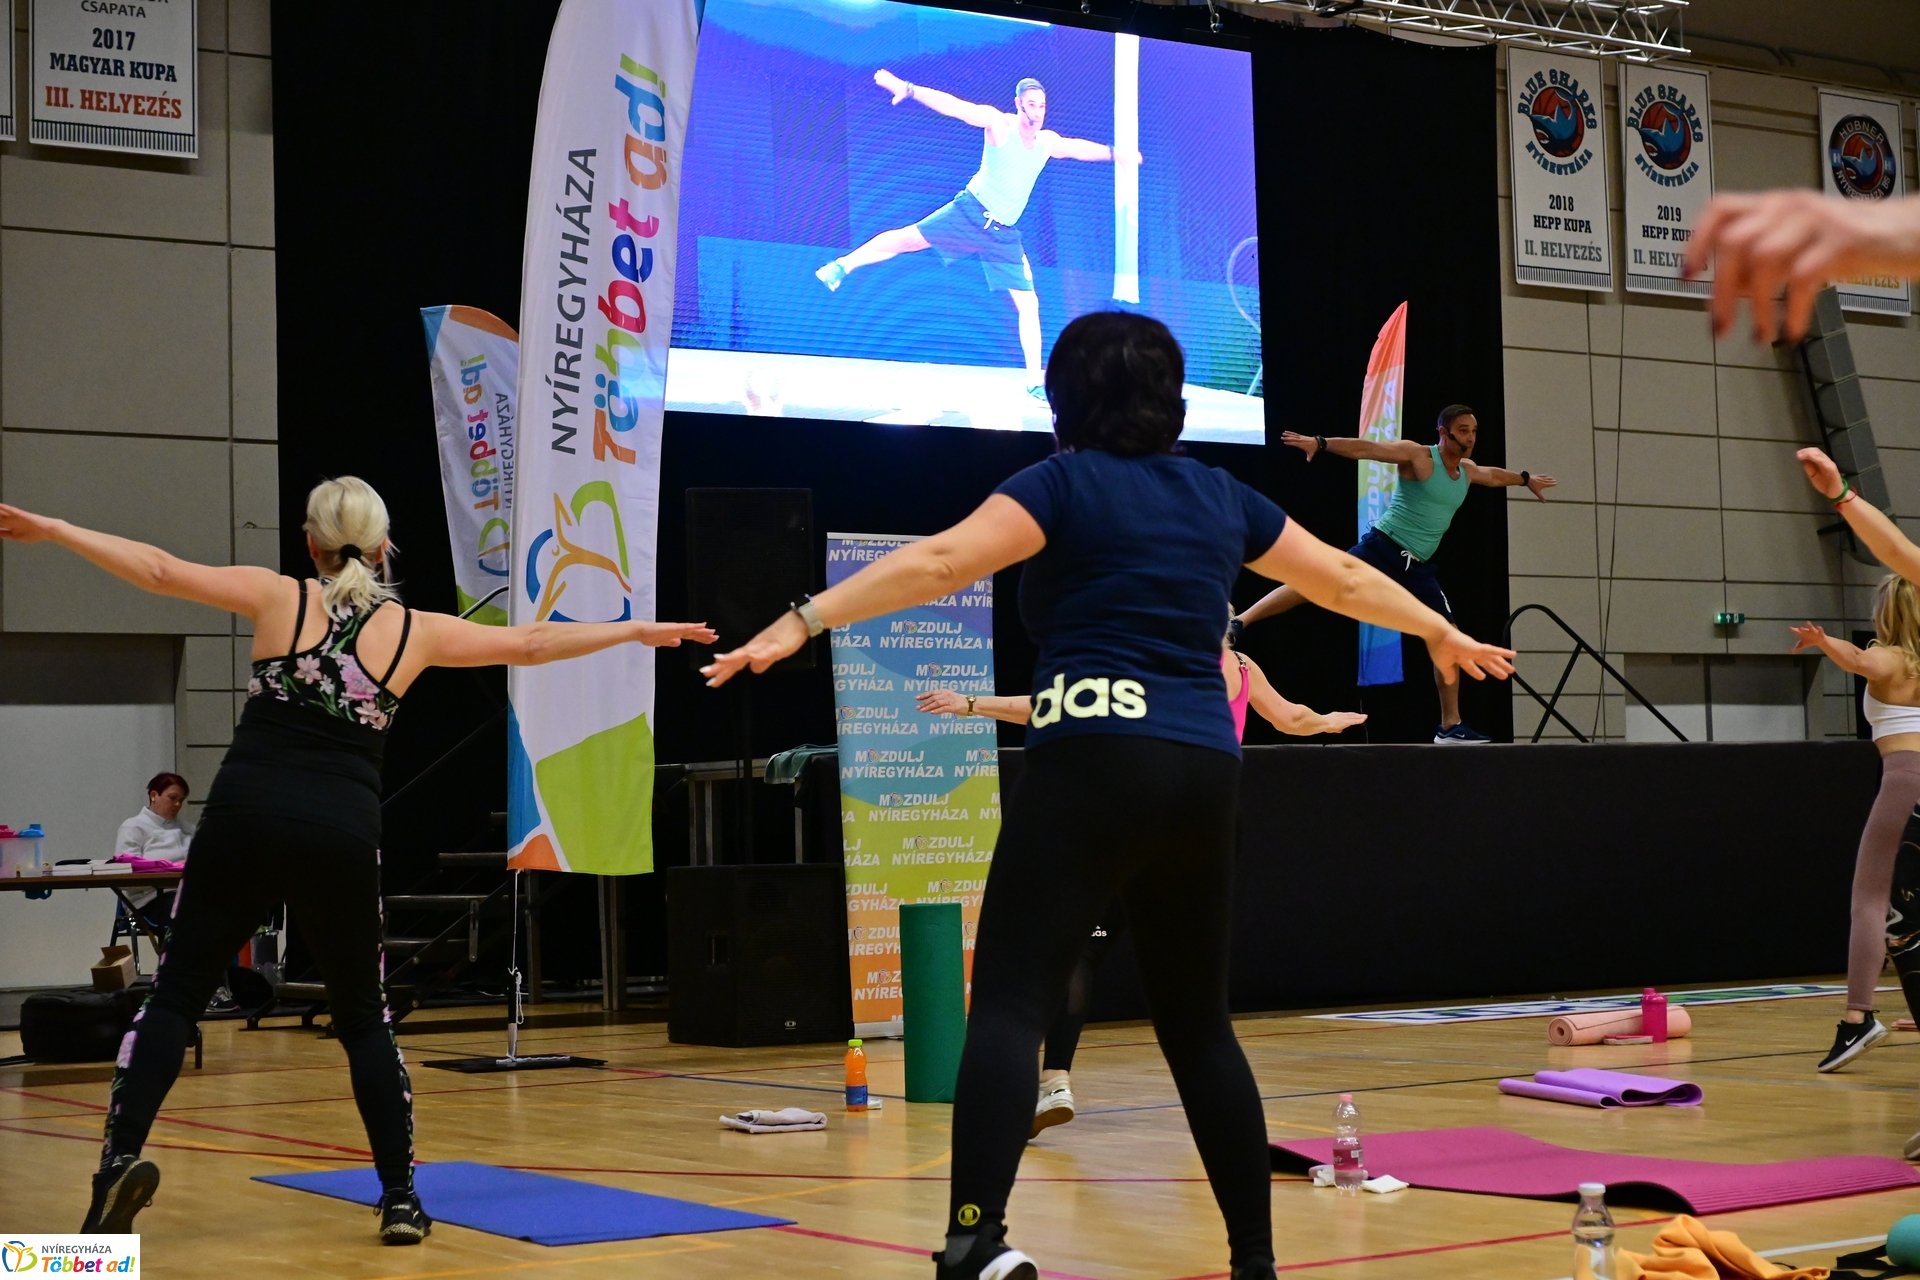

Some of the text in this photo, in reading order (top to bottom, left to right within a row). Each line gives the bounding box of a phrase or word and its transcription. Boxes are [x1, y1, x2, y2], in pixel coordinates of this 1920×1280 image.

[80, 0, 147, 18] CSAPATA
[92, 27, 136, 51] 2017
[49, 52, 178, 82] MAGYAR KUPA
[45, 85, 182, 119] III. HELYEZÉS
[1517, 68, 1598, 130] BLUE SHARKS
[1627, 83, 1704, 143] BLUE SHARKS
[1548, 193, 1575, 212] 2018
[1657, 204, 1682, 222] 2019
[1533, 214, 1592, 234] HEPP KUPA
[1641, 224, 1669, 240] HEPP
[593, 52, 668, 466] Többet ad!
[1524, 239, 1603, 263] II. HELYEZÉS
[1633, 248, 1646, 265] II.
[545, 147, 597, 456] NYÍREGYHÁZA
[828, 546, 891, 562] NYÍREG
[880, 634, 982, 649] NYÍREGYHÁZA
[1031, 673, 1148, 729] das
[841, 763, 944, 778] NYÍREGYHÁZA
[868, 806, 969, 822] NYÍREGYHÁZA
[892, 848, 993, 865] NYÍREGYHÁZA
